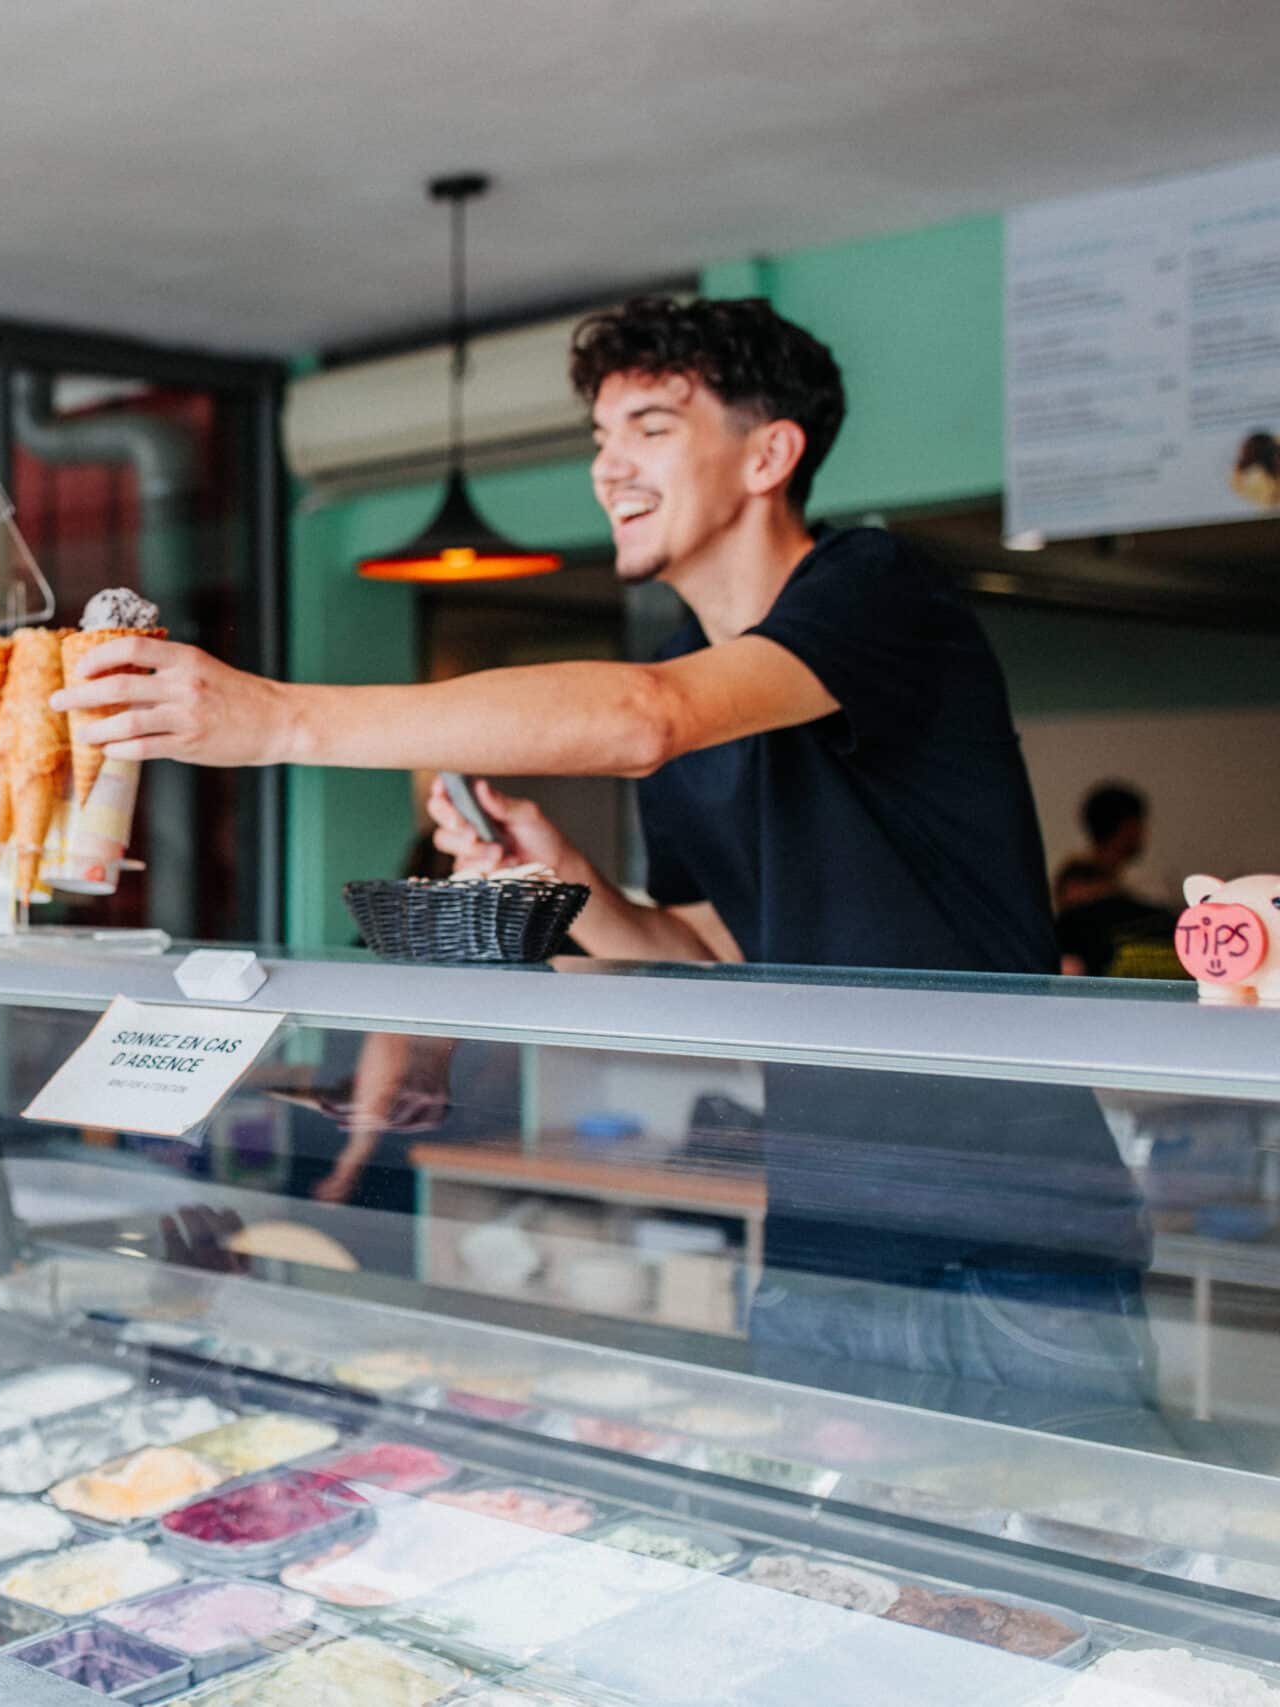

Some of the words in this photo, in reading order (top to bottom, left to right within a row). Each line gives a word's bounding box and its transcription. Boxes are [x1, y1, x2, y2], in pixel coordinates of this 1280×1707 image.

[112, 1031, 179, 1048] SONNEZ
[177, 1036, 206, 1051] EN
[203, 1038, 242, 1054] CAS
[110, 1052, 205, 1073] D'ABSENCE
